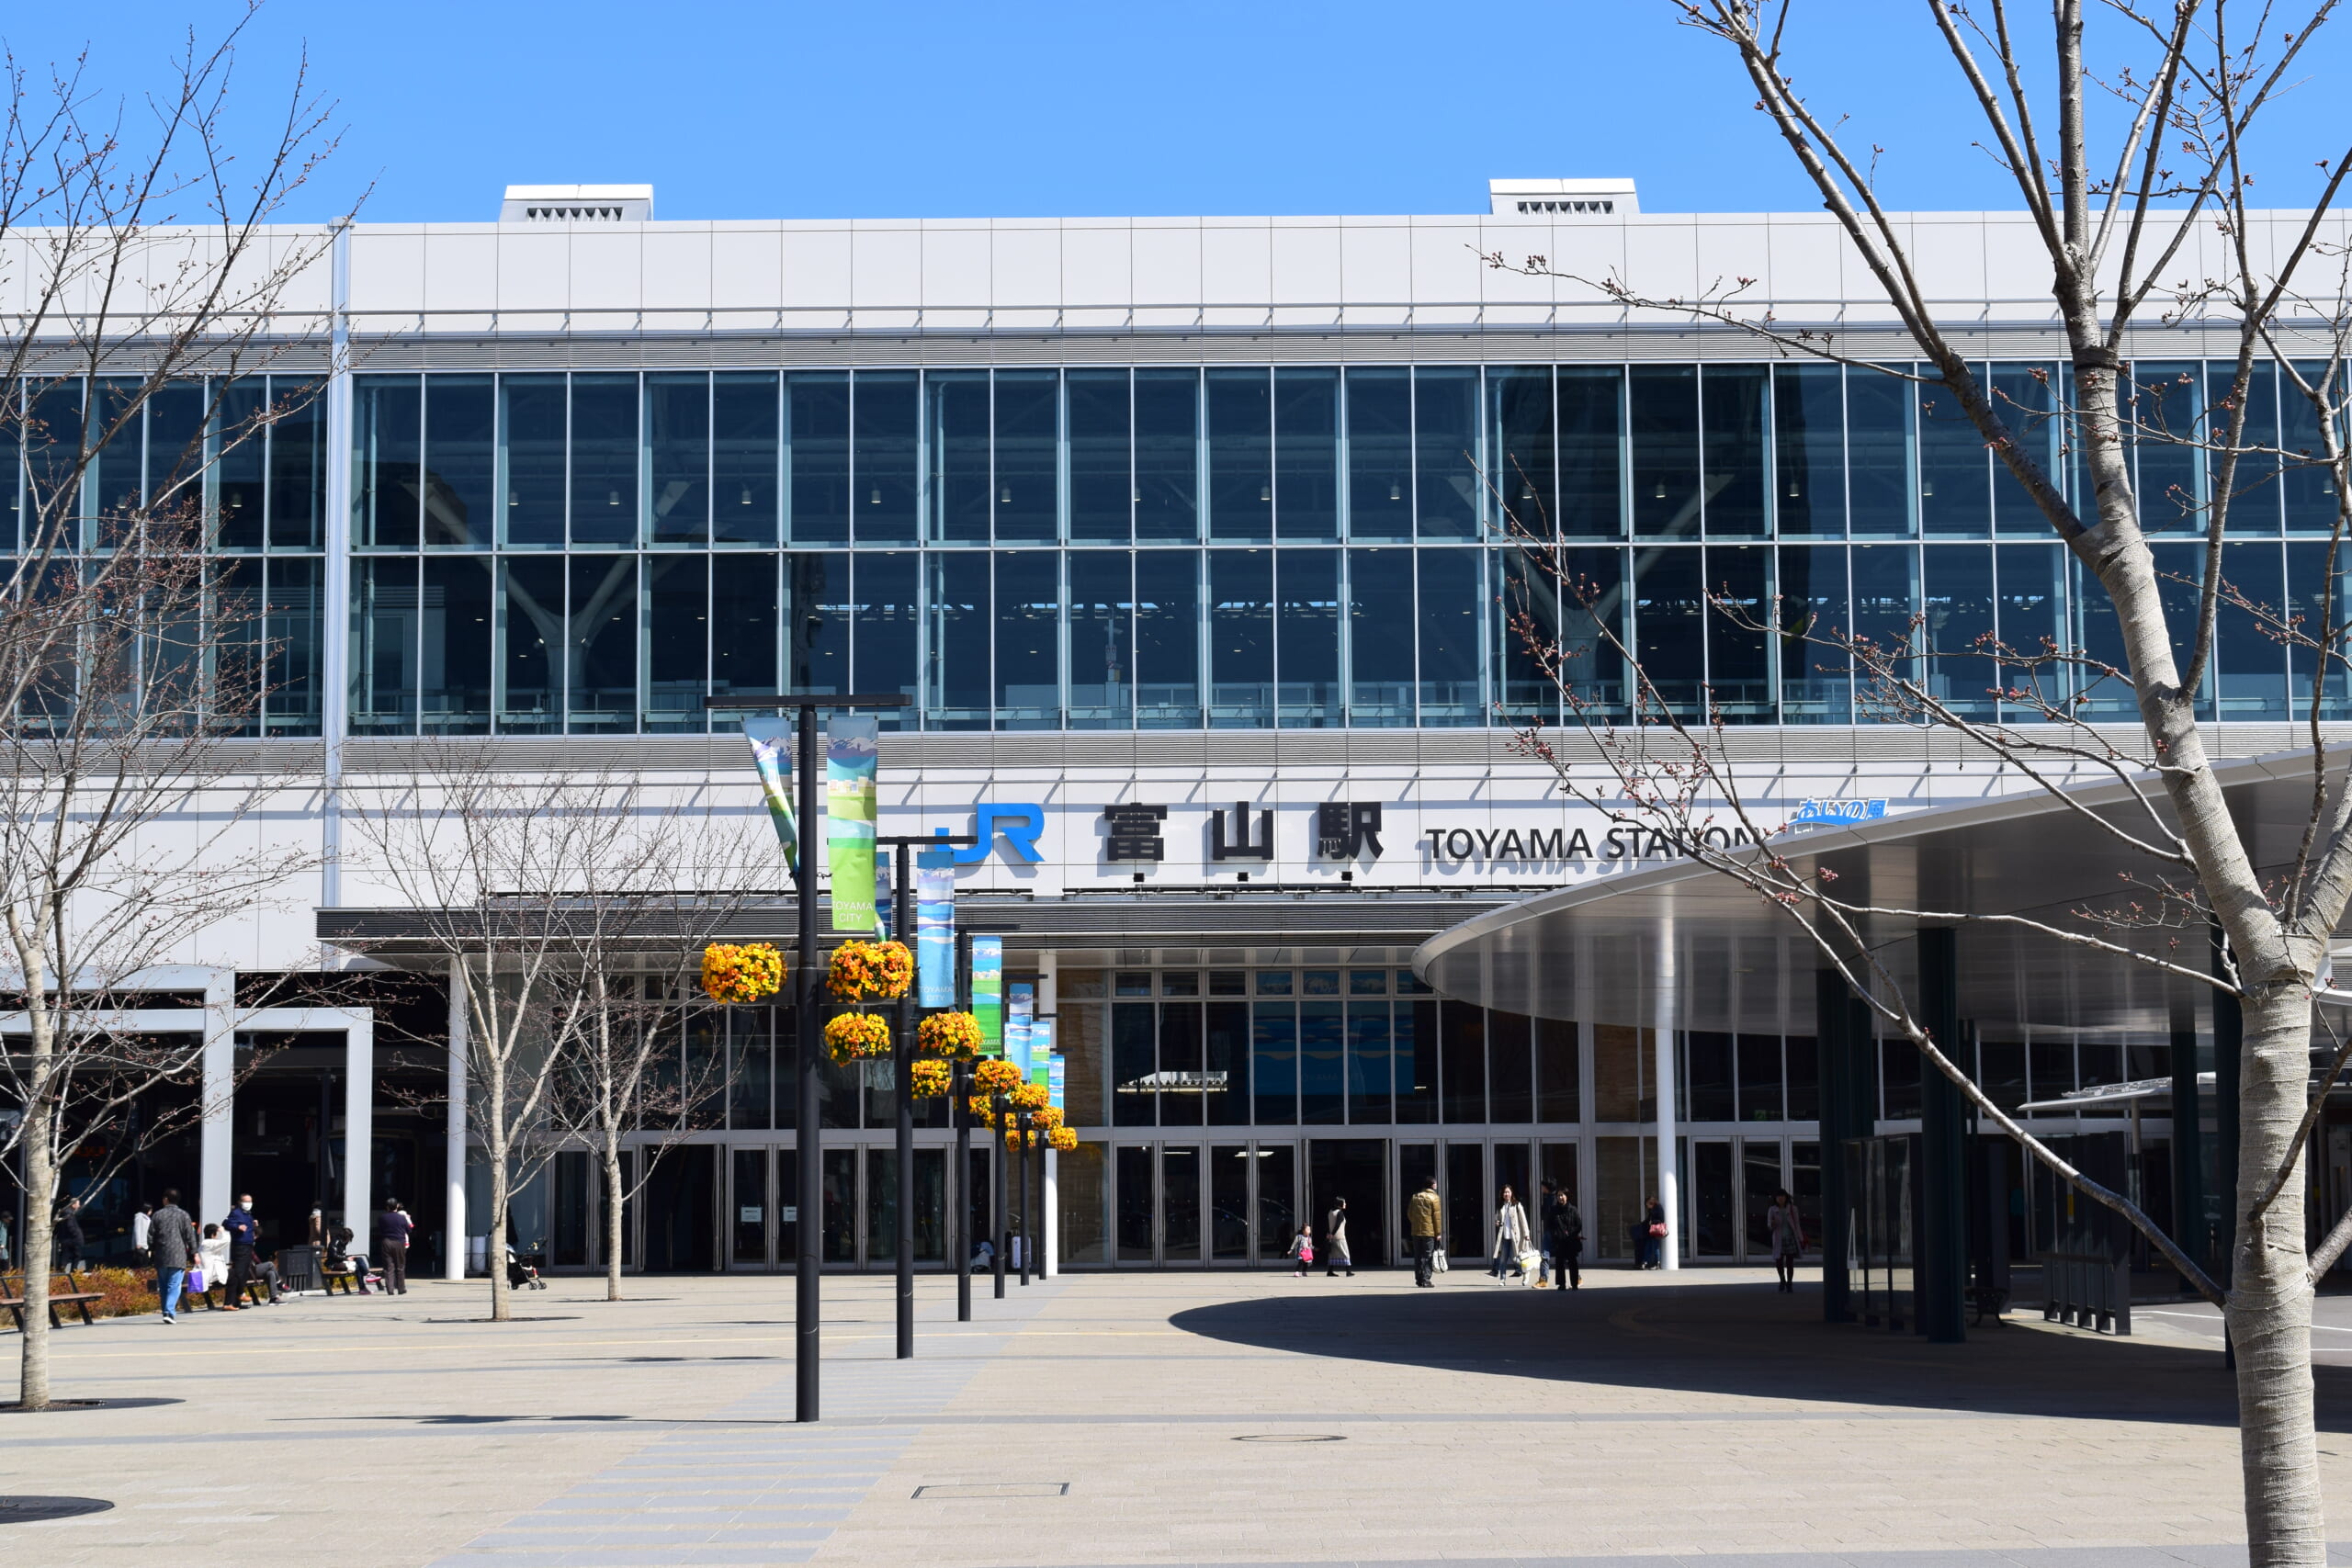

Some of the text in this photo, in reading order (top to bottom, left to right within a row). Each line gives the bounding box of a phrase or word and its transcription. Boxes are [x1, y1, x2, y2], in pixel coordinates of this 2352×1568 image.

[933, 802, 1046, 863] JR
[1103, 801, 1385, 862] 富山駅
[1425, 827, 1593, 860] TOYAMA
[839, 912, 863, 923] CITY
